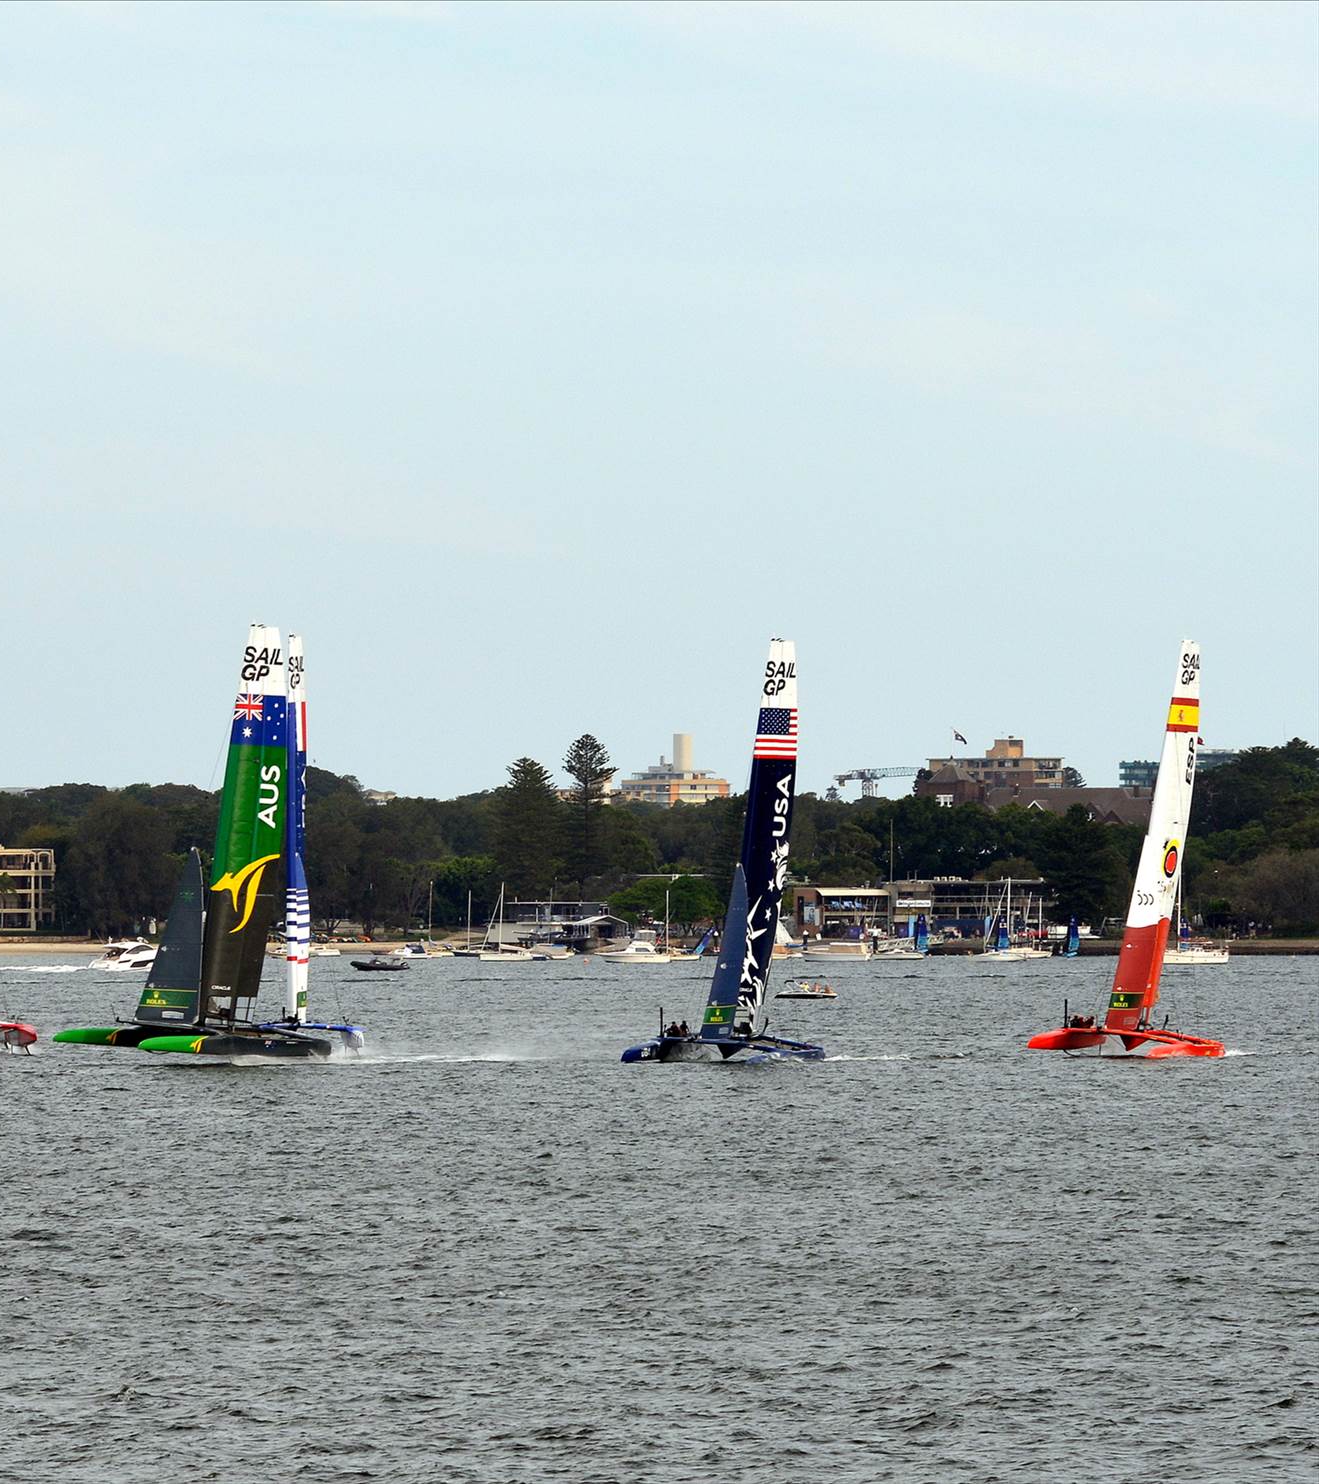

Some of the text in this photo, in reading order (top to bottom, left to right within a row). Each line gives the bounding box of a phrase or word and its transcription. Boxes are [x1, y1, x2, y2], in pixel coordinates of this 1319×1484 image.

[243, 646, 284, 666] SAIL
[241, 664, 270, 681] GP
[765, 660, 796, 678] SAIL
[1181, 669, 1196, 685] GP
[763, 679, 786, 696] GP
[1185, 737, 1195, 786] ESP
[257, 765, 281, 829] AUS
[772, 774, 792, 837] USA
